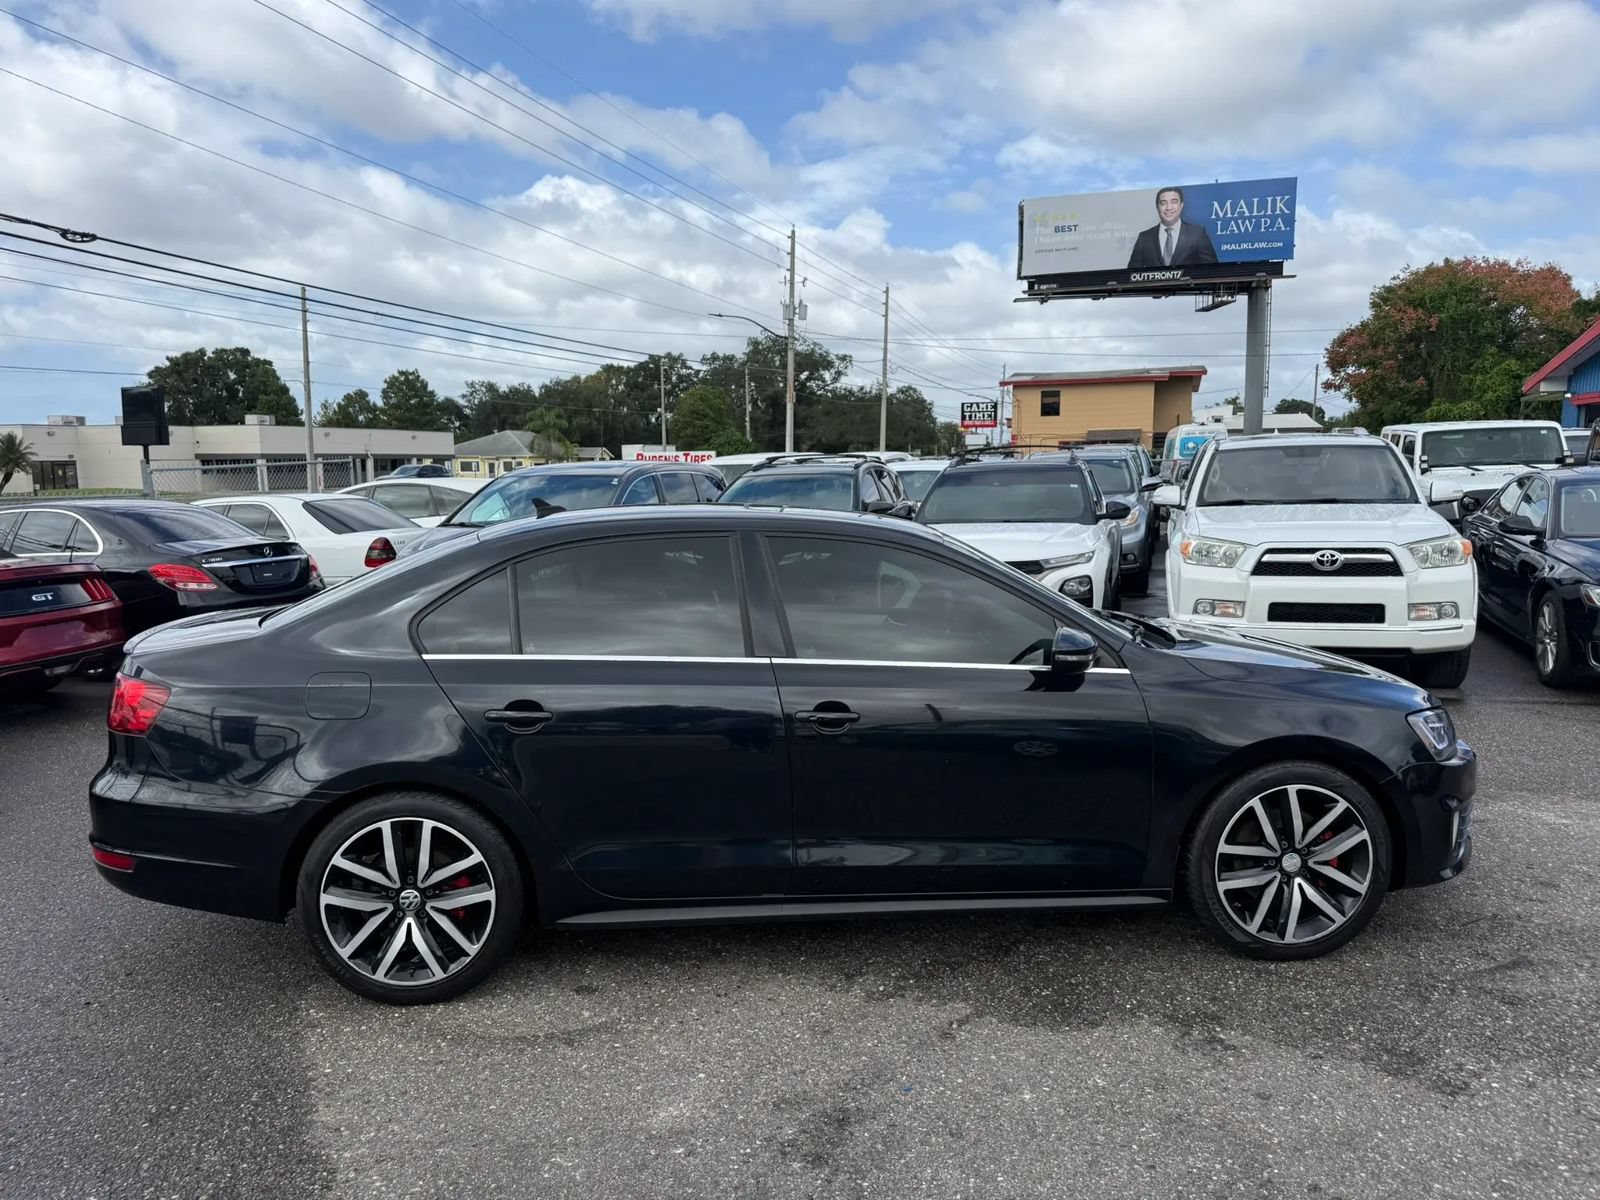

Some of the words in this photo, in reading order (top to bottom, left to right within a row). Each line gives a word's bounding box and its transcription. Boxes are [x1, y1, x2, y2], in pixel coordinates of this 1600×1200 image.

[1210, 195, 1291, 219] MALIK
[1054, 224, 1079, 233] BEST
[1216, 218, 1256, 235] LAW
[1260, 217, 1290, 232] P.A.
[964, 403, 994, 411] GAME
[31, 592, 54, 601] GT
